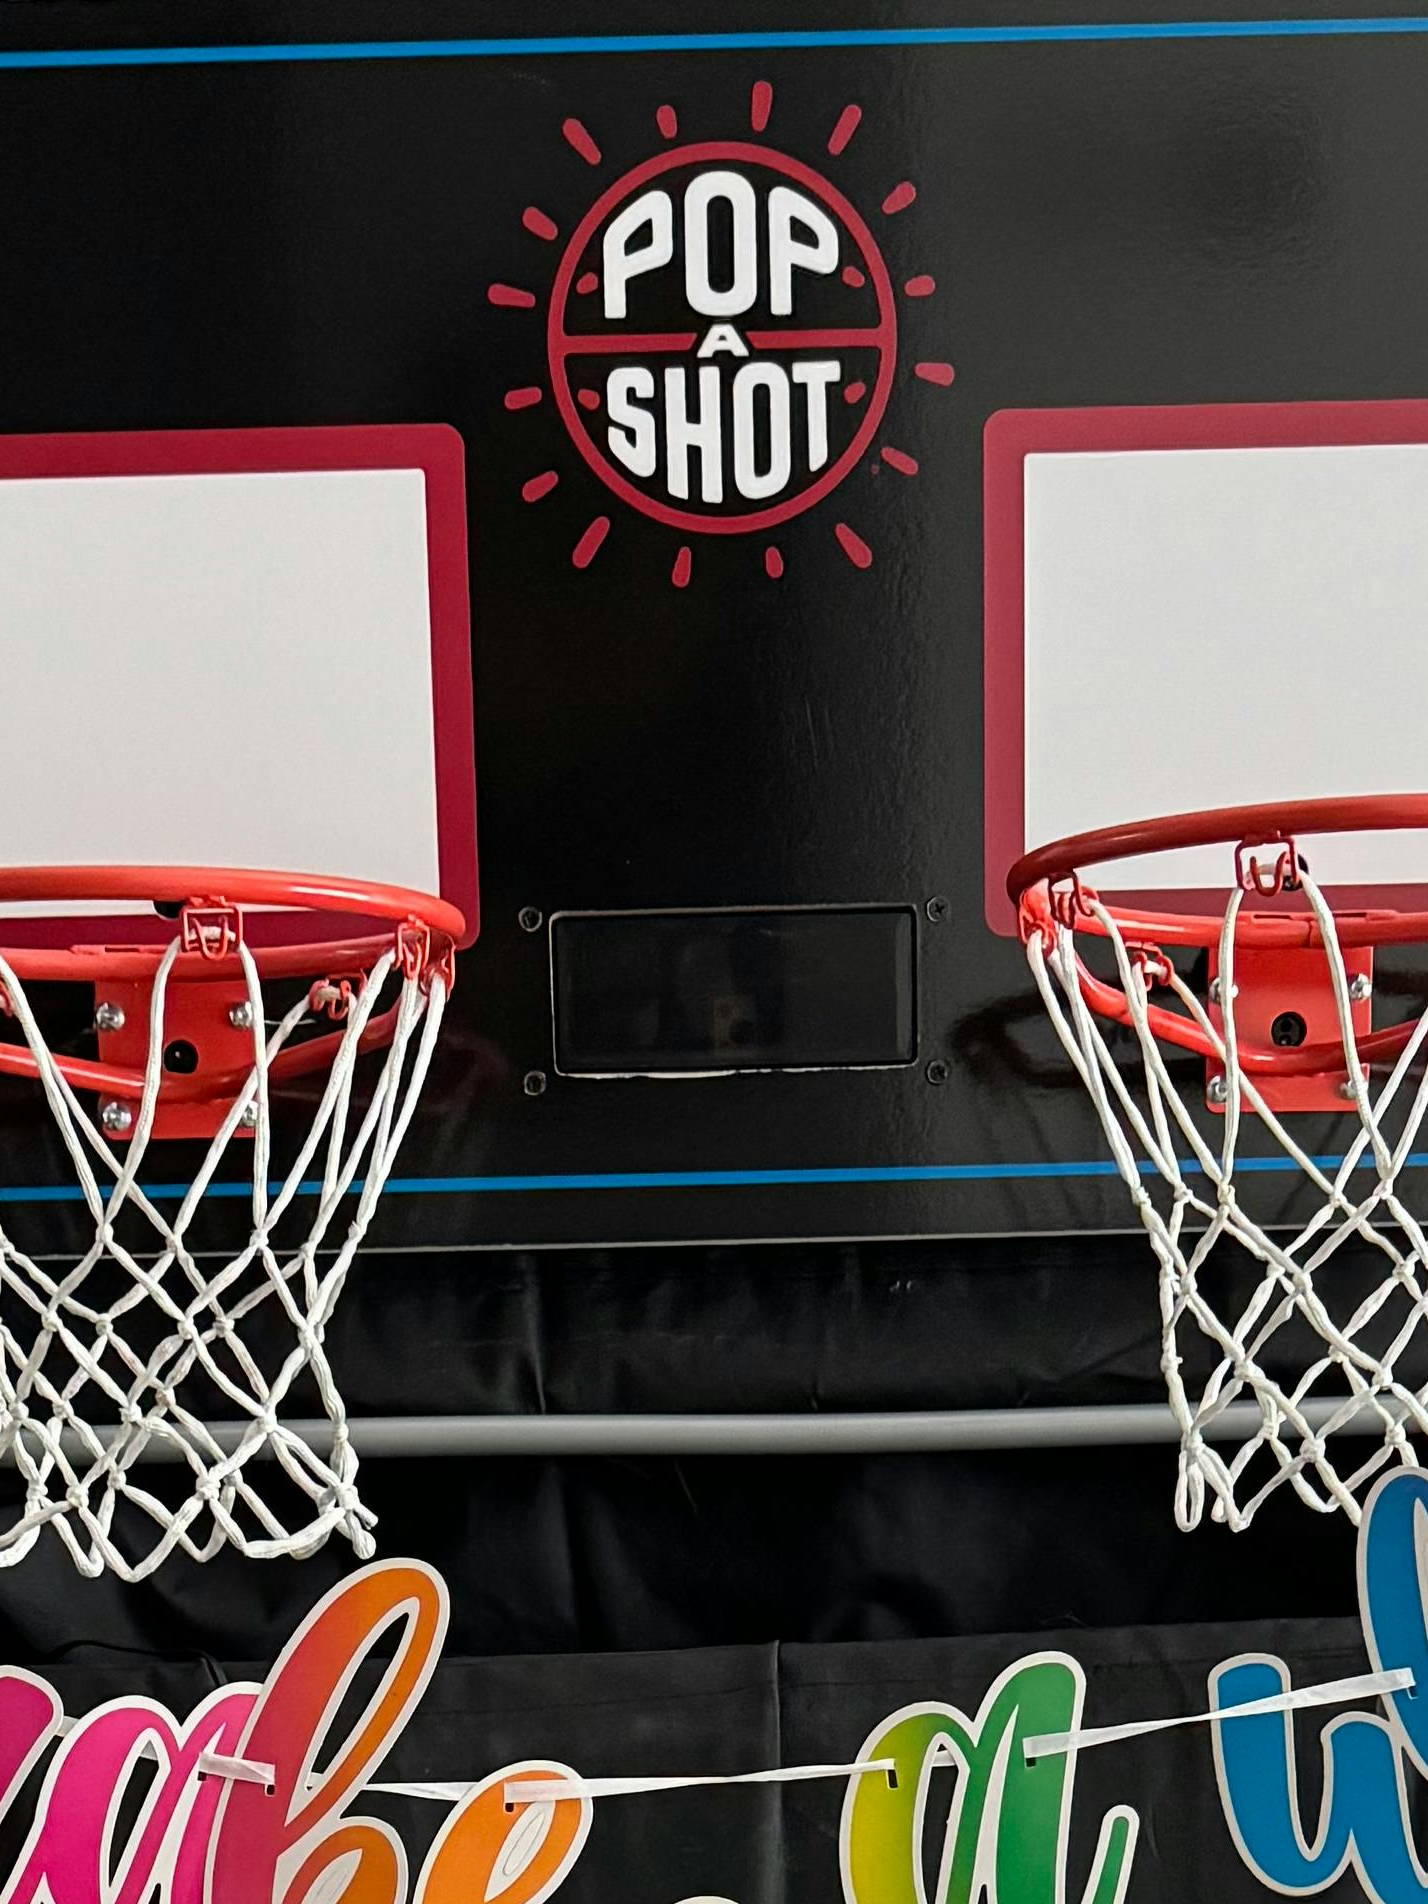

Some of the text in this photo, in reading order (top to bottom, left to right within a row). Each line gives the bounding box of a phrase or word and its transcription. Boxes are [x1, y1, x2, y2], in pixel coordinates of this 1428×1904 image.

[603, 170, 839, 319] POP
[697, 323, 749, 358] A
[607, 361, 841, 503] SHOT
